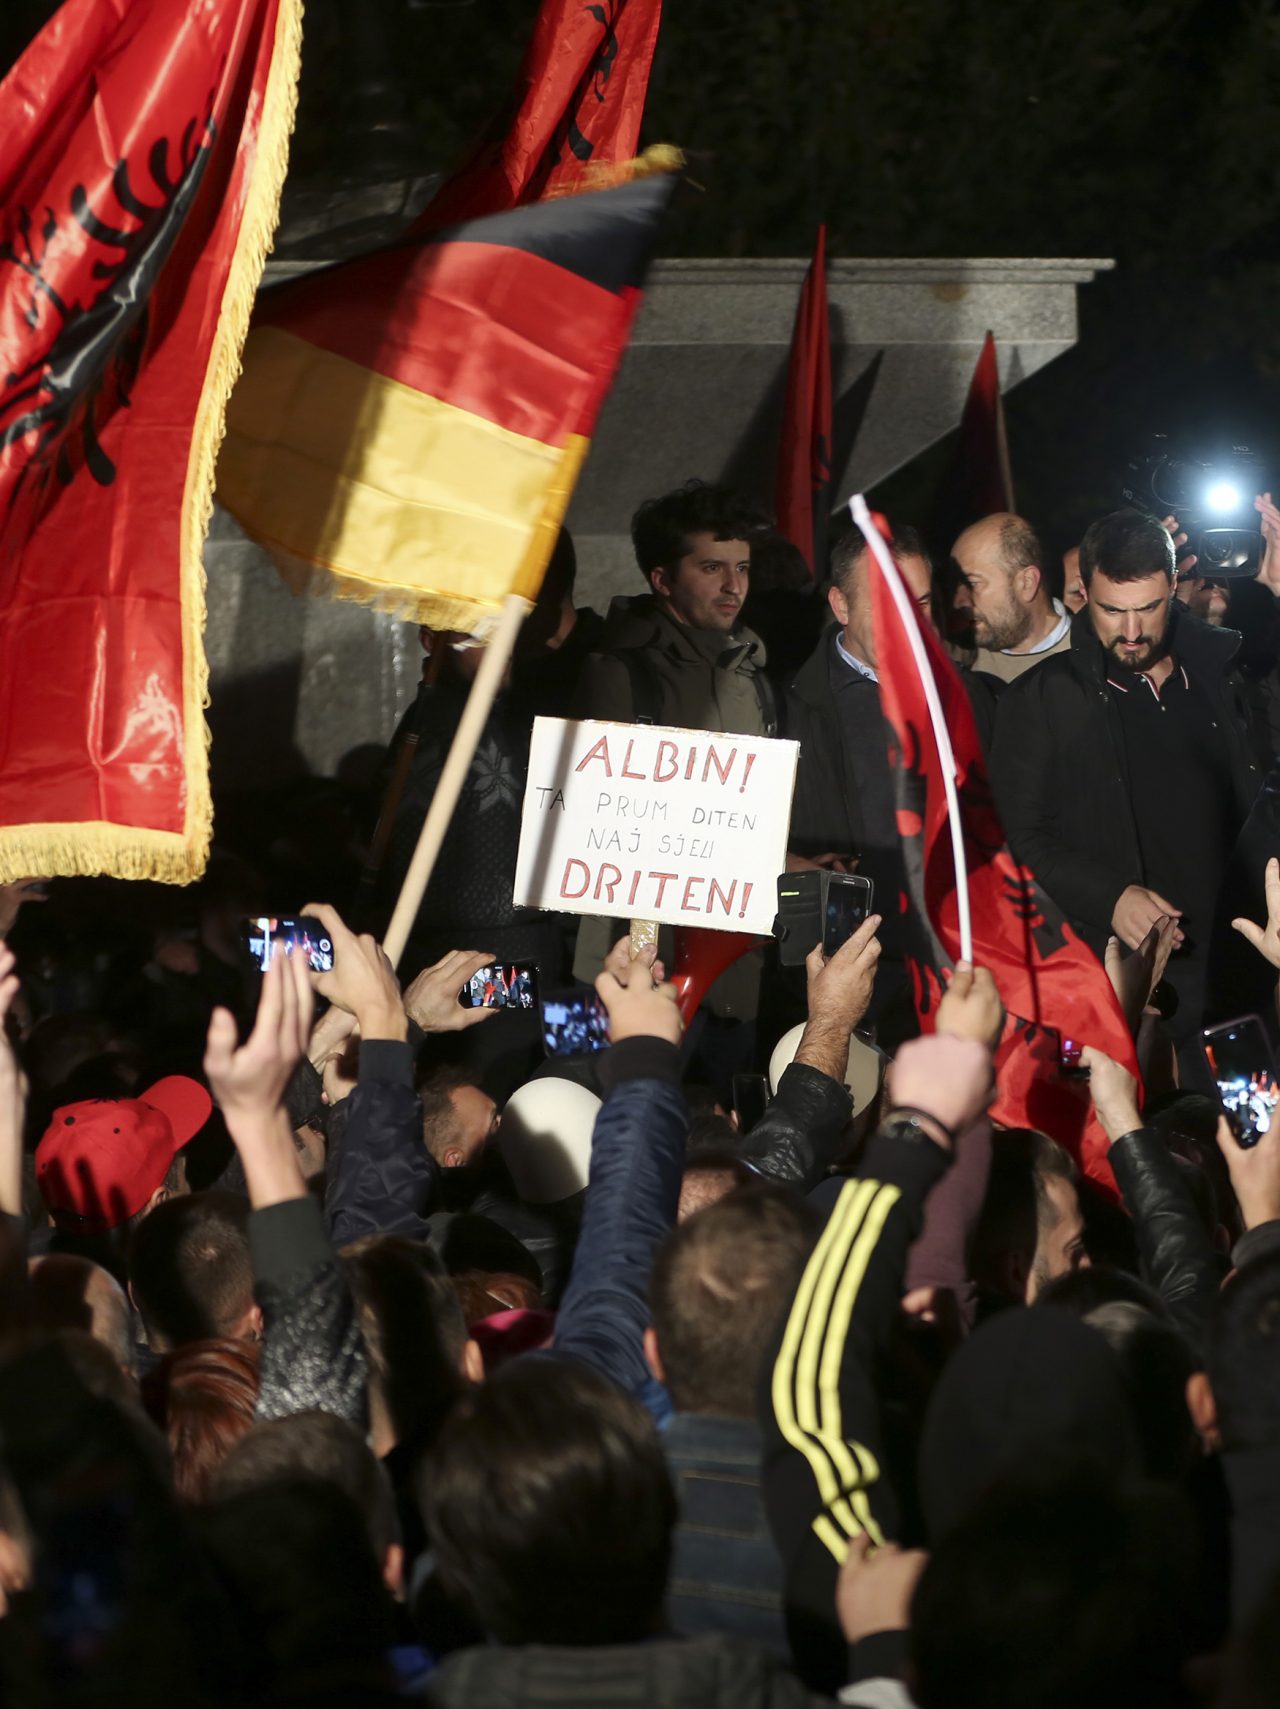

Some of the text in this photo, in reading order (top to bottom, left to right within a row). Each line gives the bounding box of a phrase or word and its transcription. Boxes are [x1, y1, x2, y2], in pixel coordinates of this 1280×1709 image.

[575, 735, 757, 794] ALBIN!
[536, 786, 757, 831] TA PRUM DITEN
[559, 857, 754, 918] DRITEN!
